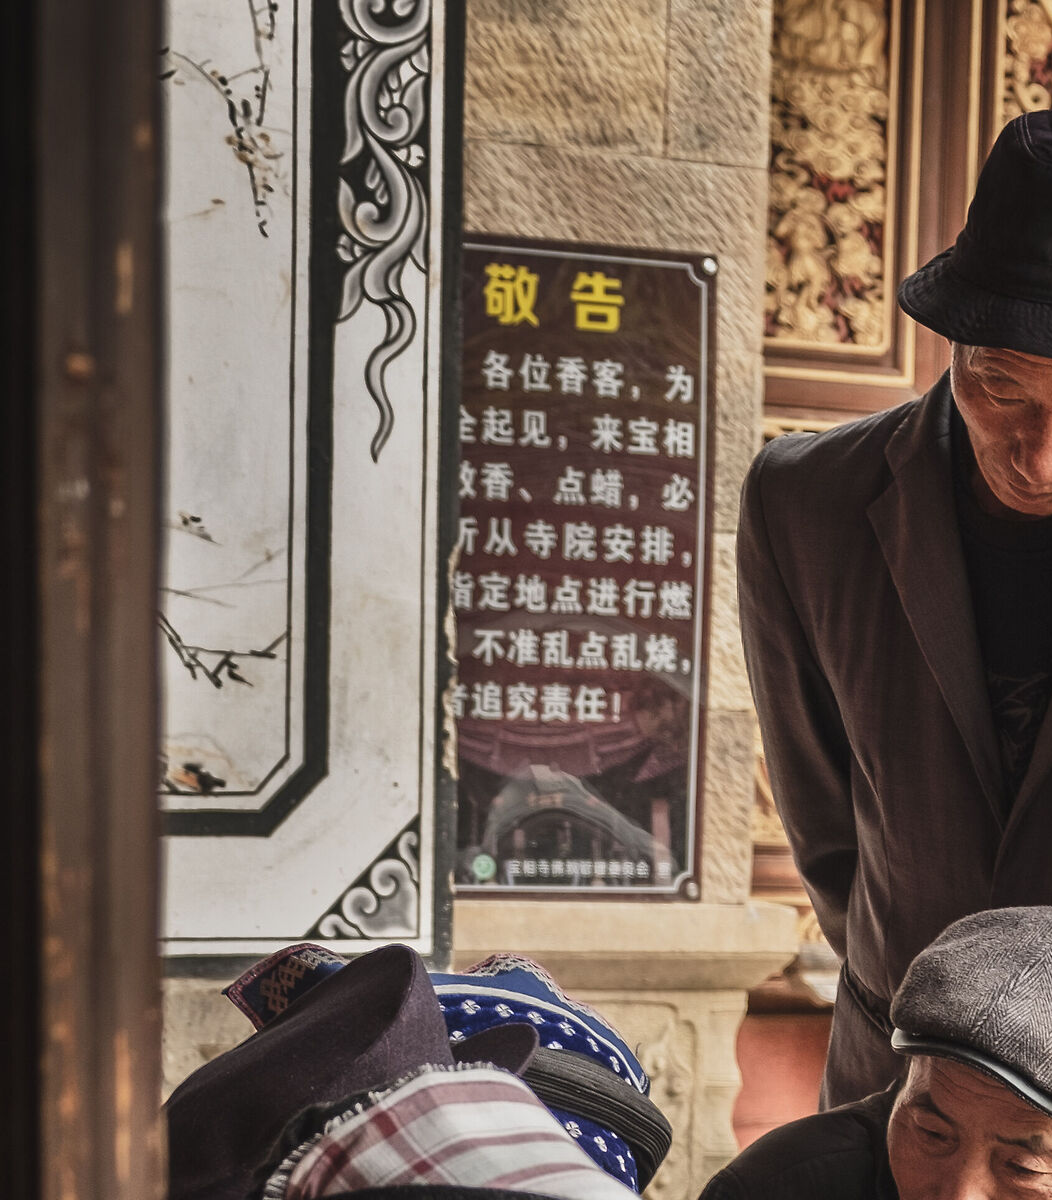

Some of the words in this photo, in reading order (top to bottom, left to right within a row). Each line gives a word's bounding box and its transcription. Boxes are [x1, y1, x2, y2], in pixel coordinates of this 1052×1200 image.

[484, 263, 624, 332] 敬告
[482, 351, 694, 402] 各位香客，为
[473, 629, 691, 674] 不准乱点乱烧，
